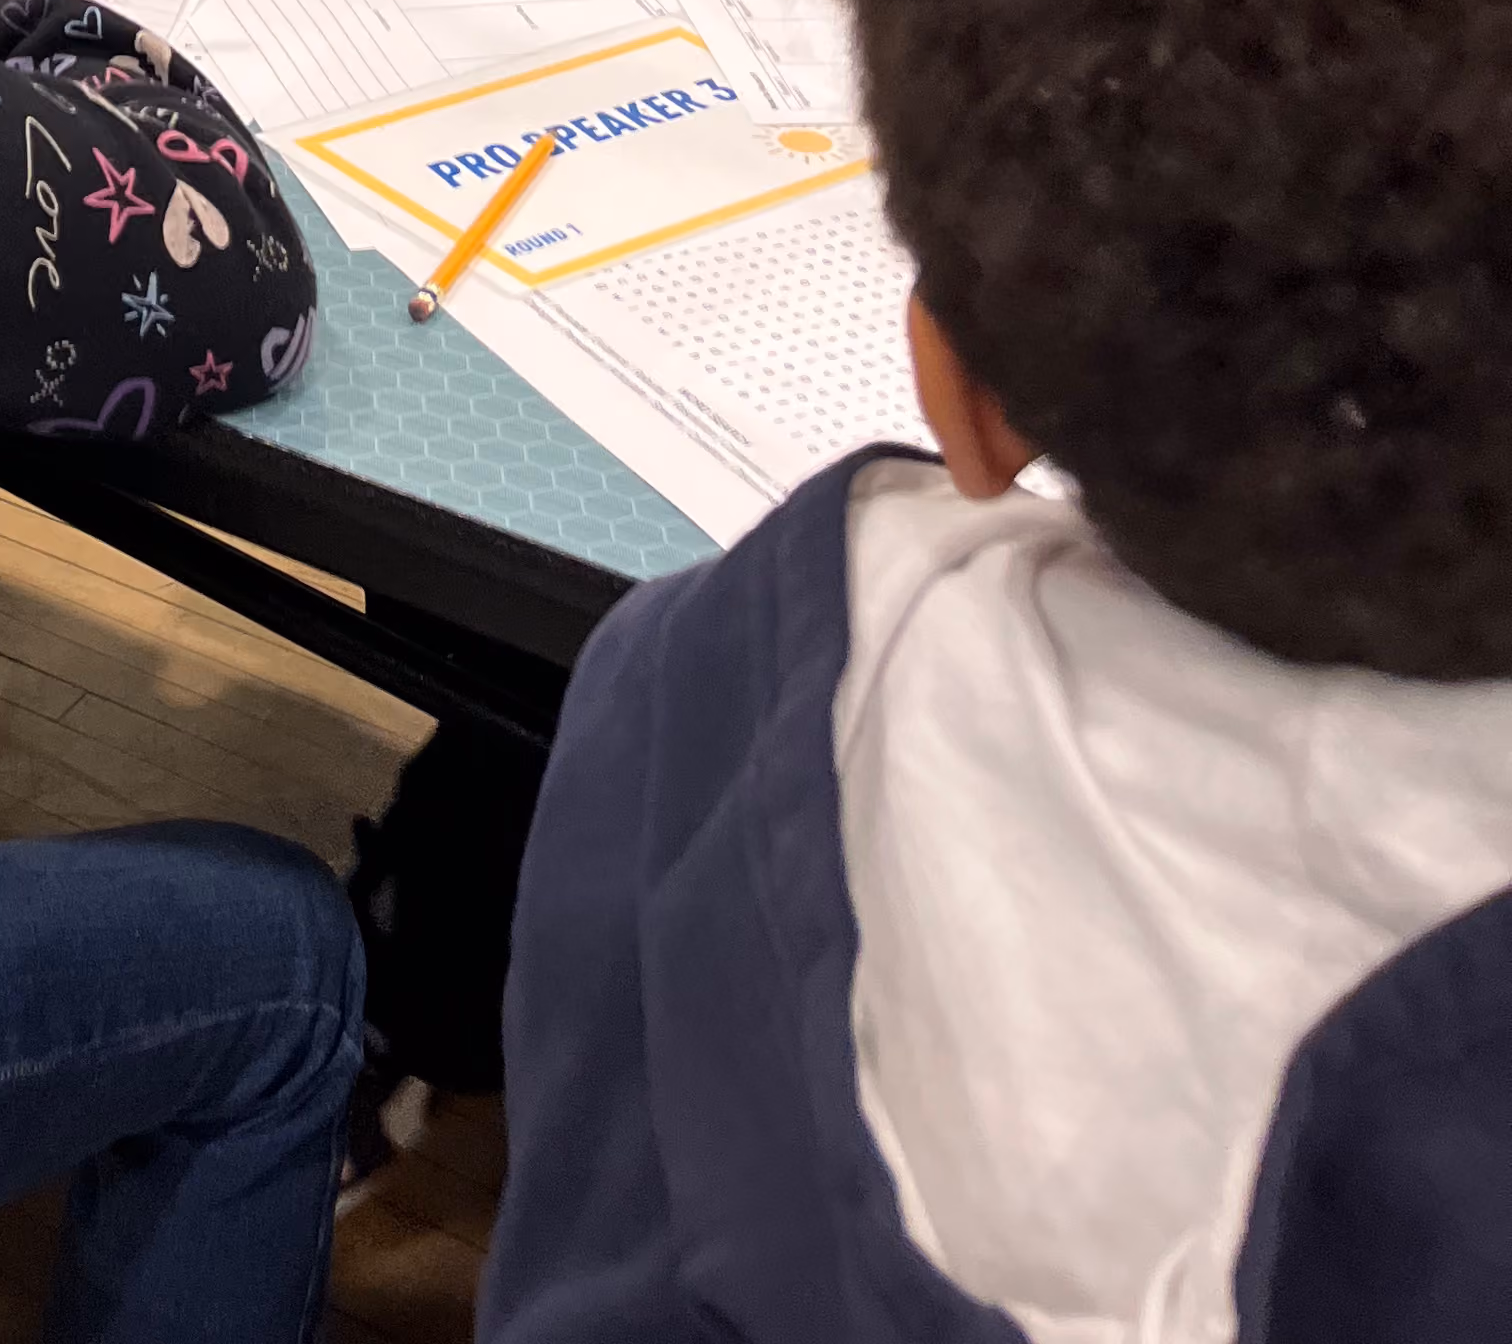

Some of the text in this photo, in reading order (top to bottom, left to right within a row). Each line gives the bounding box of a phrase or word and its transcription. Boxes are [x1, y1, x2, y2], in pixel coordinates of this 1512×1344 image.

[426, 142, 522, 188] PRO
[695, 78, 738, 102] 3
[503, 226, 568, 258] ROUND
